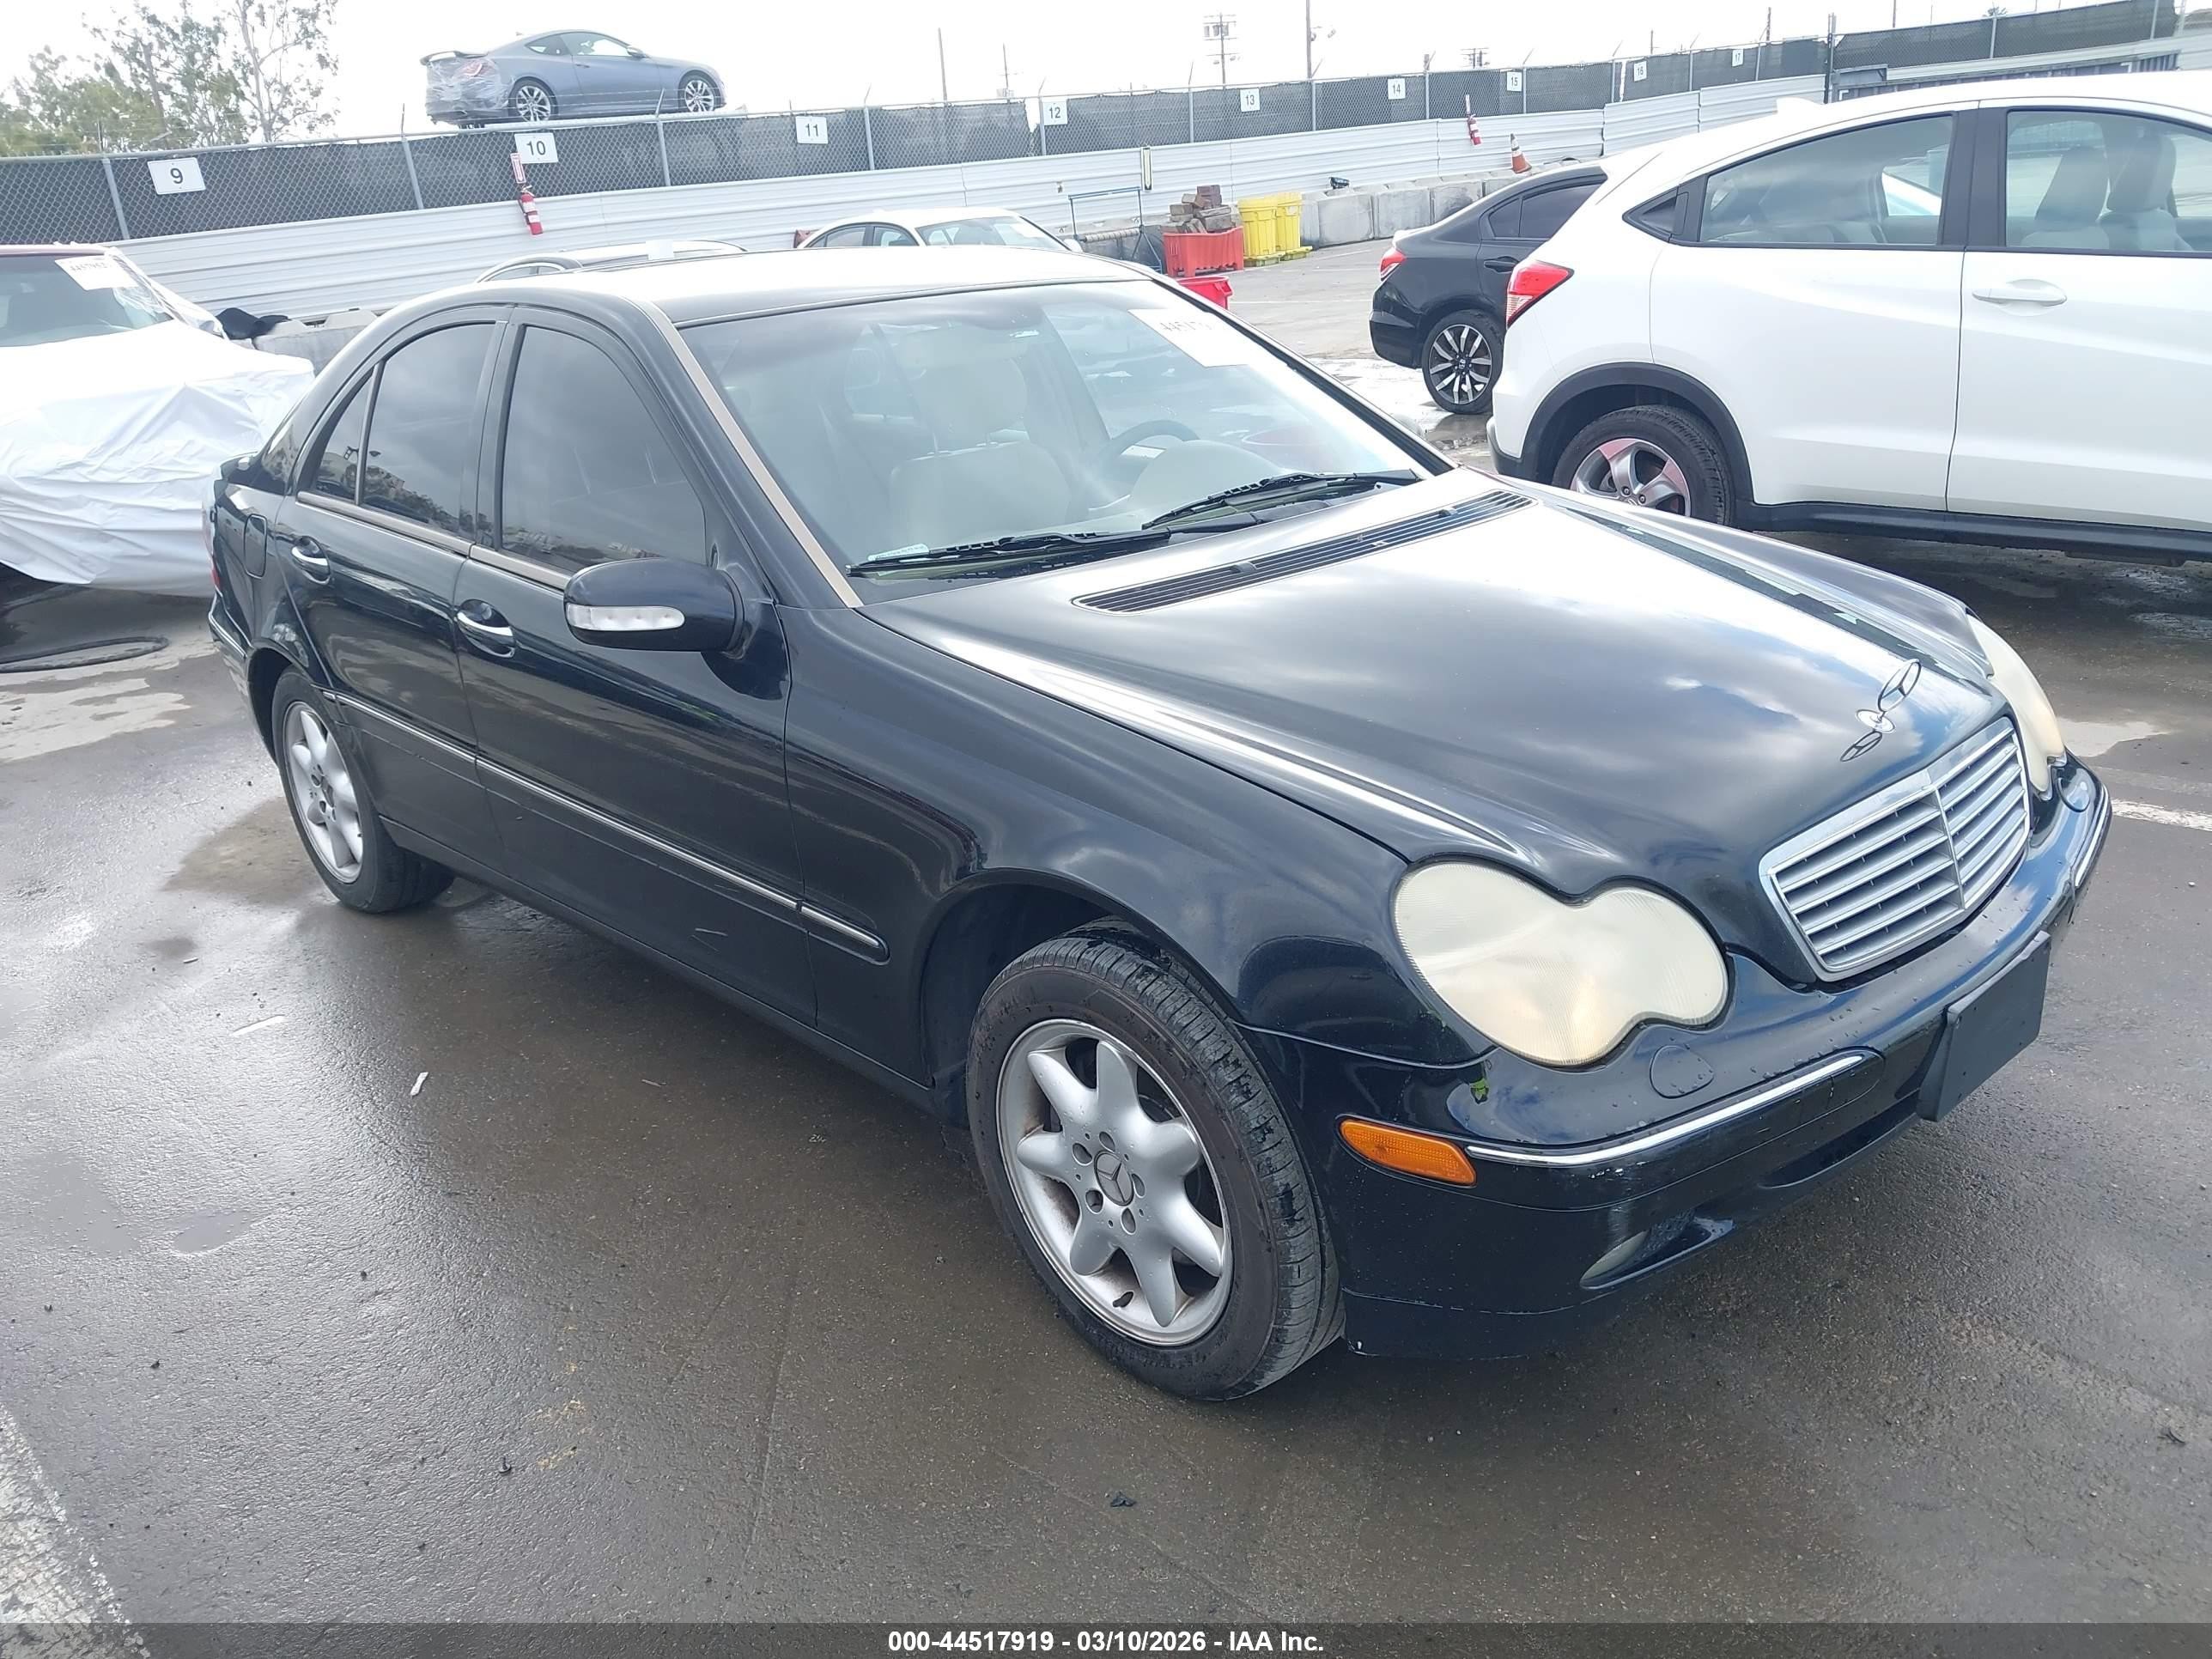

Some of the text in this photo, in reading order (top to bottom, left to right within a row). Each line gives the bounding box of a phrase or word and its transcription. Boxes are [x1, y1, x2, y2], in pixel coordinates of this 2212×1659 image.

[1510, 76, 1518, 87] 15
[1392, 83, 1401, 94] 14
[1245, 94, 1255, 106] 13
[1048, 106, 1061, 119] 12
[805, 123, 819, 137] 11
[526, 140, 546, 155] 10
[170, 167, 183, 184] 9
